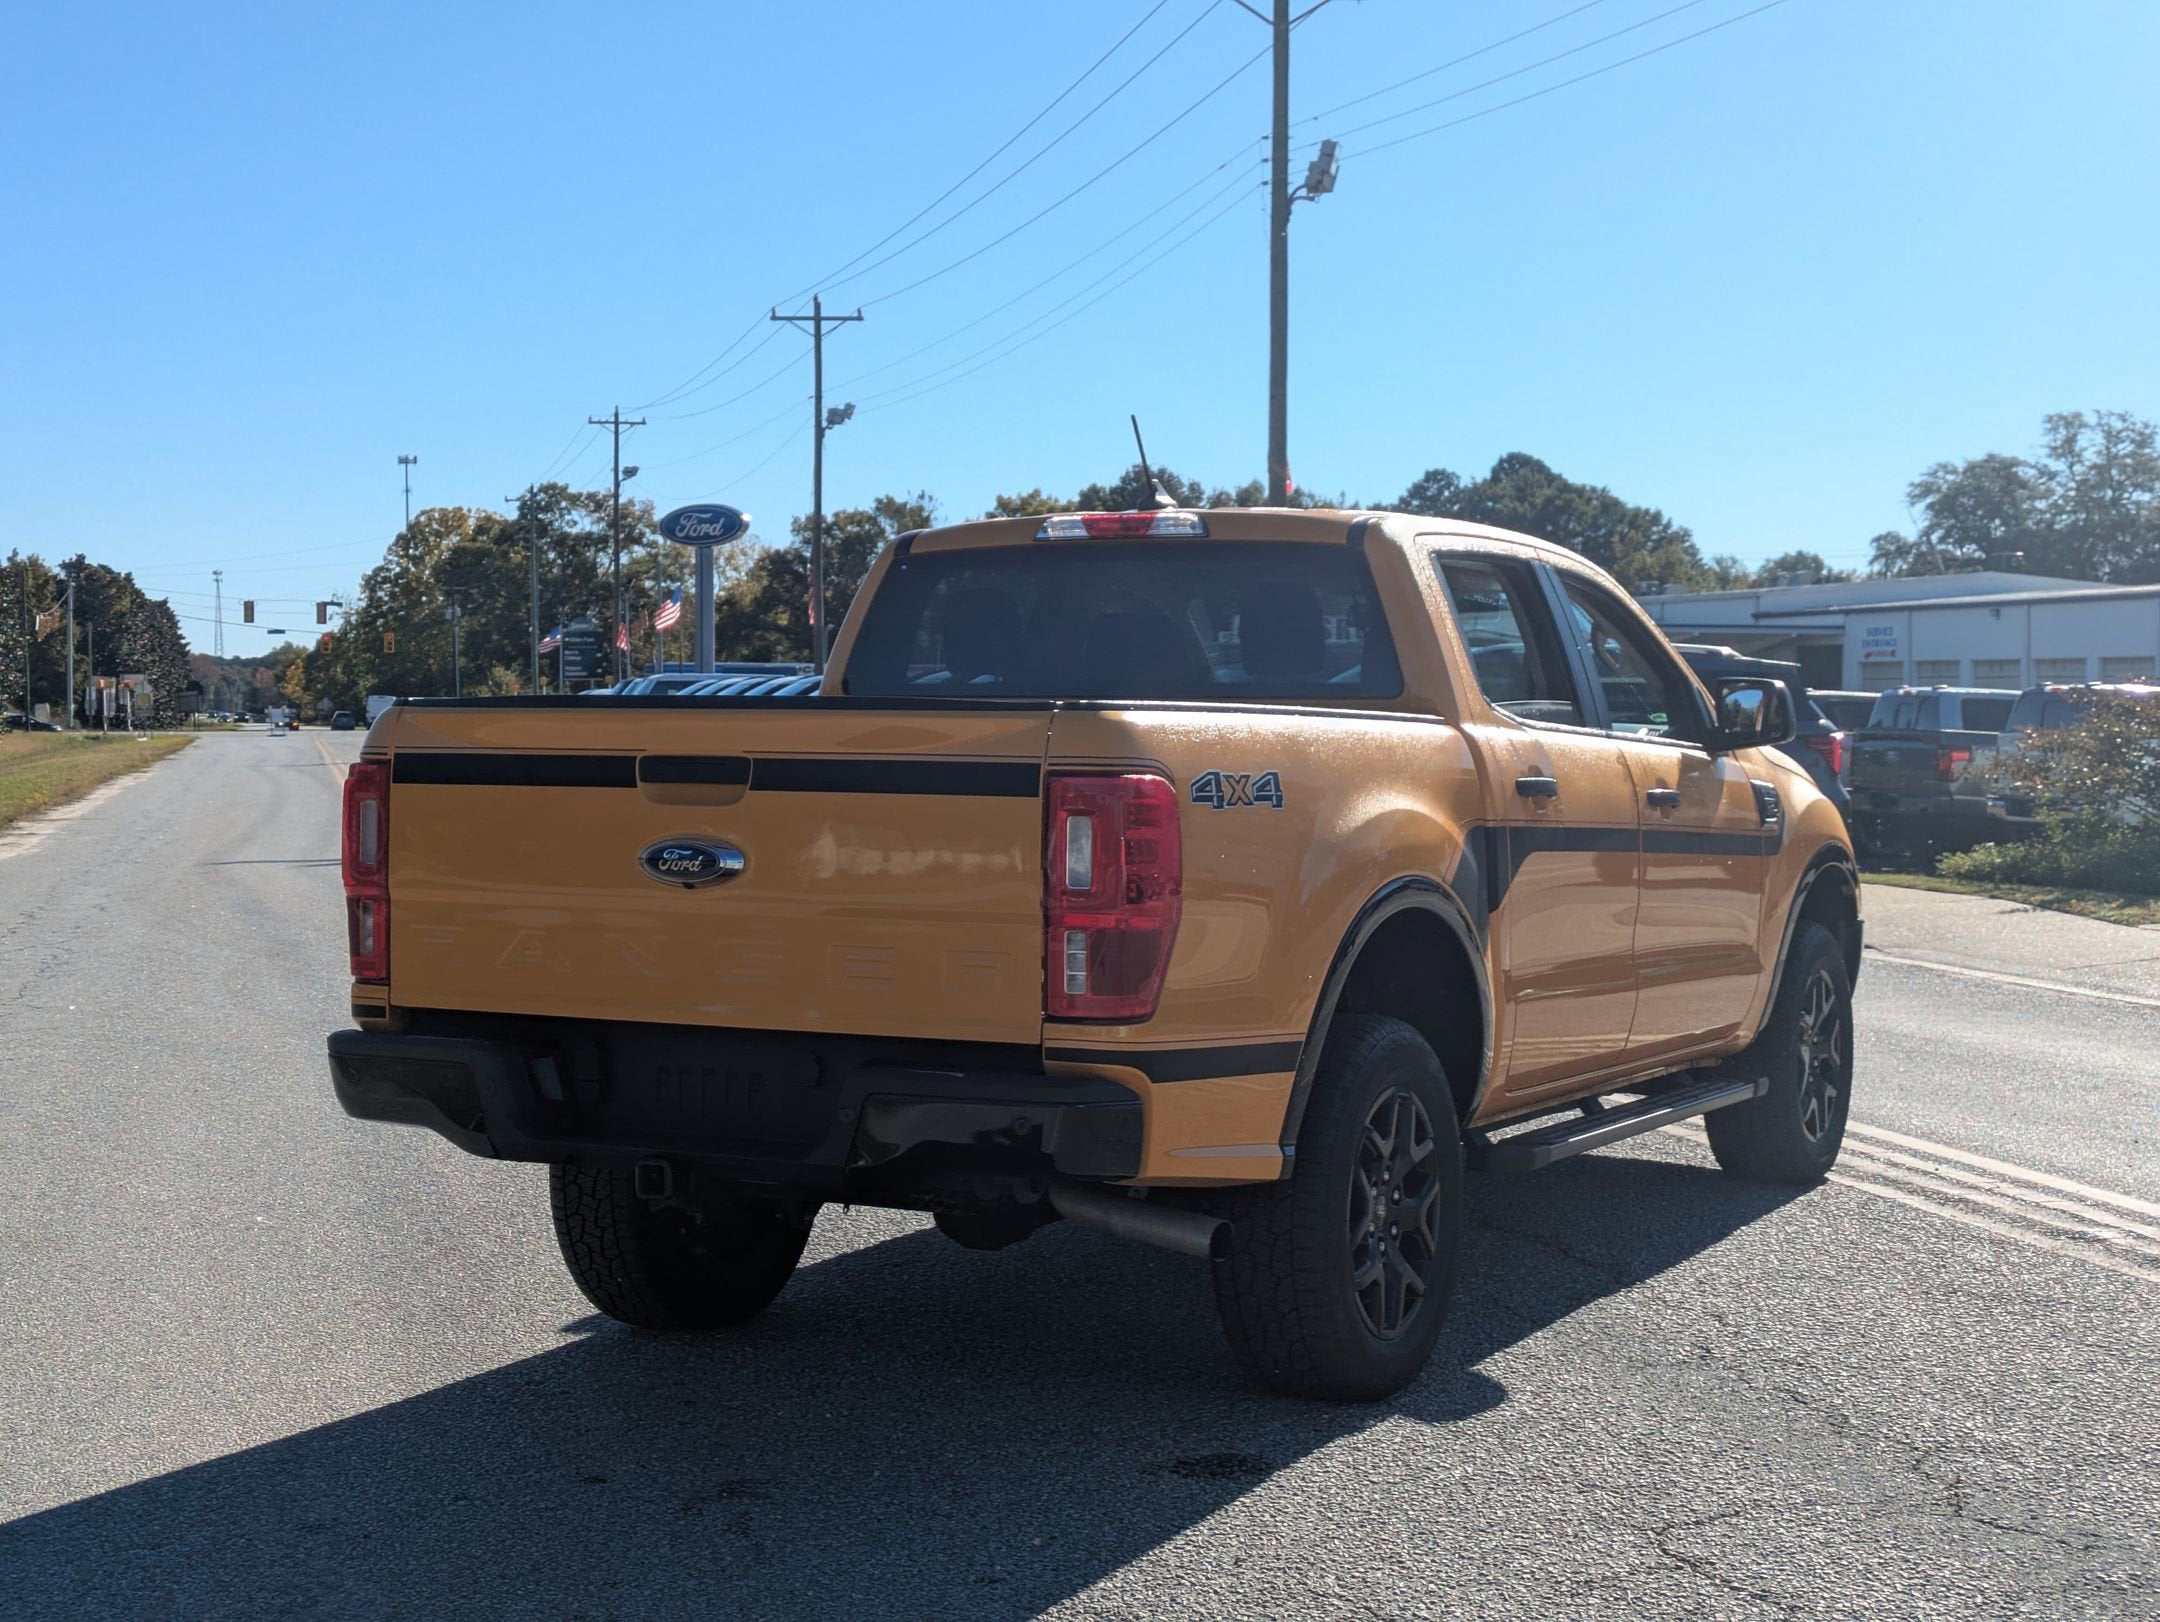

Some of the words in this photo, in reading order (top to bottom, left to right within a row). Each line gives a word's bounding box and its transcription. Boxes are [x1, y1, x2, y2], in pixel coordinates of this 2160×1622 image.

[675, 512, 725, 538] Ford
[1865, 626, 1894, 637] SERVICE
[1861, 638, 1897, 648] ENTRANCE
[658, 848, 703, 872] Ford
